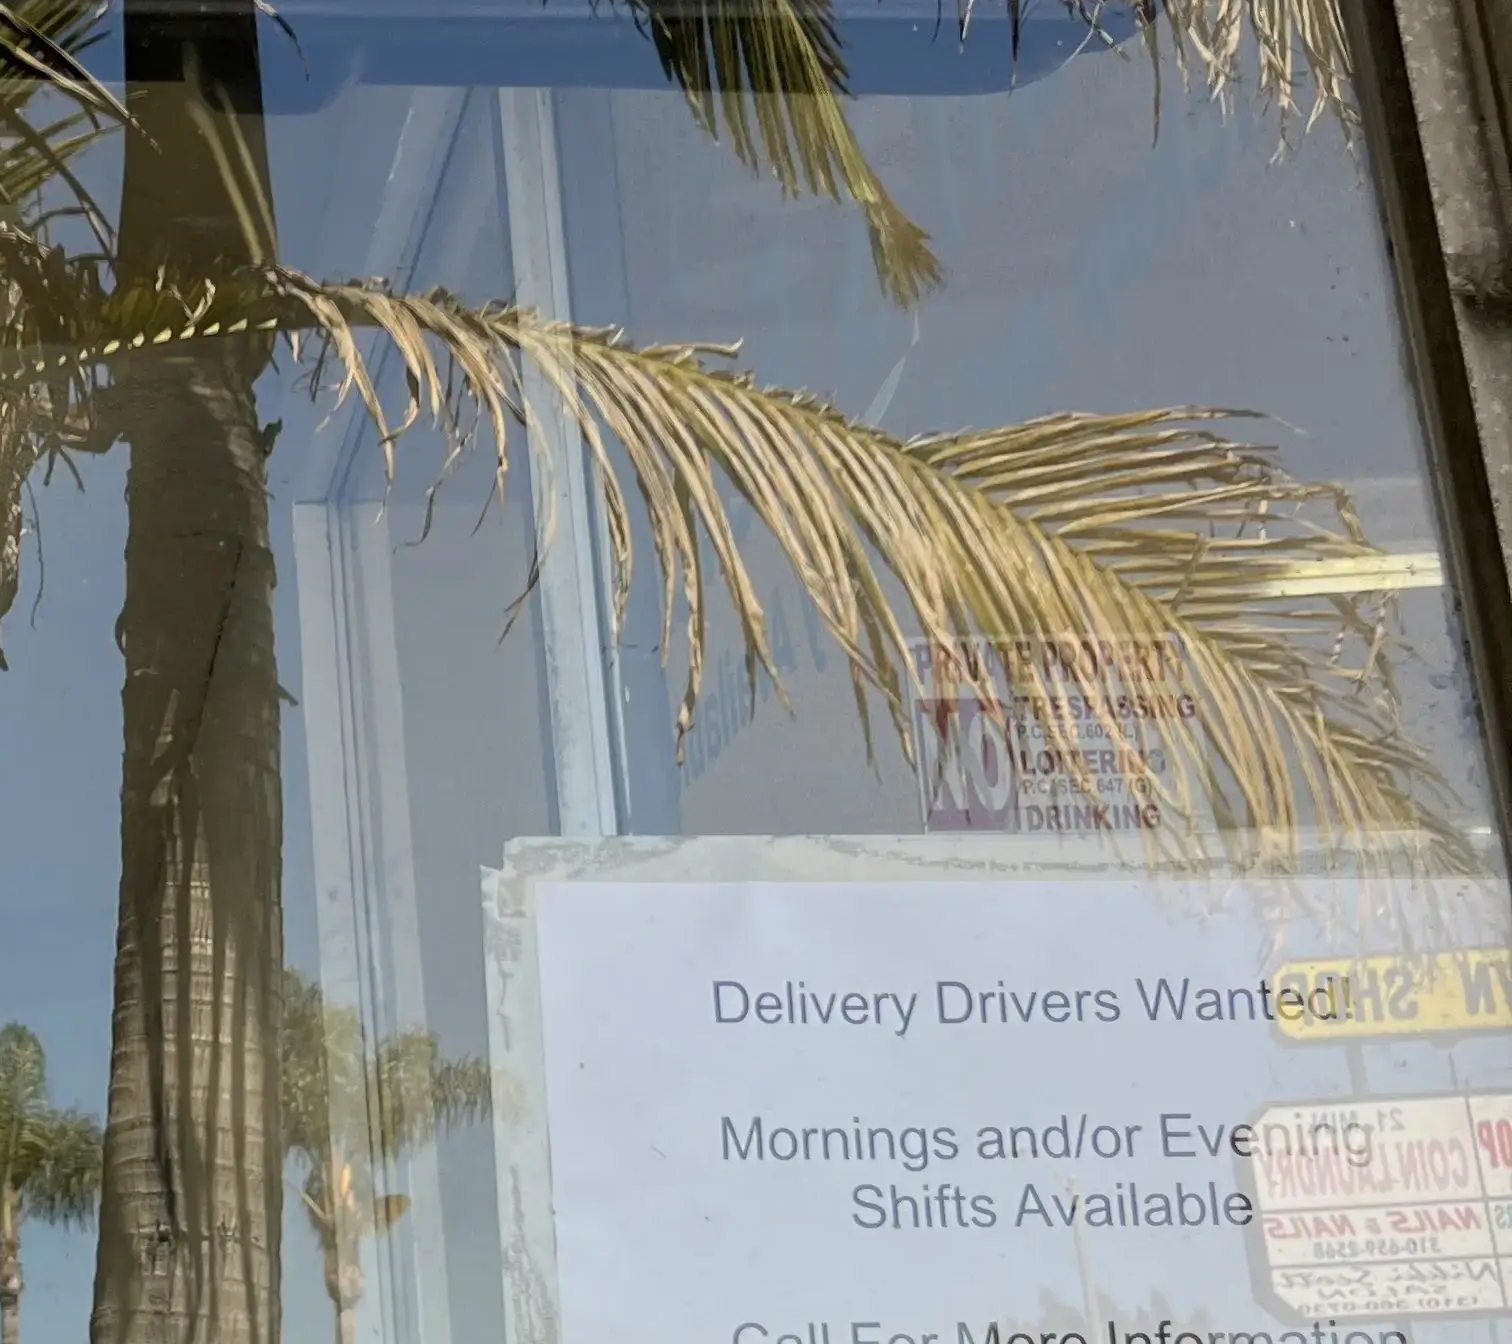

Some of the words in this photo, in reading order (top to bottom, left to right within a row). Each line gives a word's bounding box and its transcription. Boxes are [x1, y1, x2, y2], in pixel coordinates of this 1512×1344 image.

[1025, 803, 1162, 831] DRINKING
[713, 979, 918, 1039] Delivery
[936, 979, 1121, 1026] Drivers
[1135, 975, 1356, 1023] Wanted!
[720, 1115, 959, 1172] Mornings
[976, 1112, 1142, 1160] and/or
[1160, 1110, 1375, 1170] Evening
[851, 1182, 998, 1231] Shifts
[1014, 1181, 1253, 1229] Available
